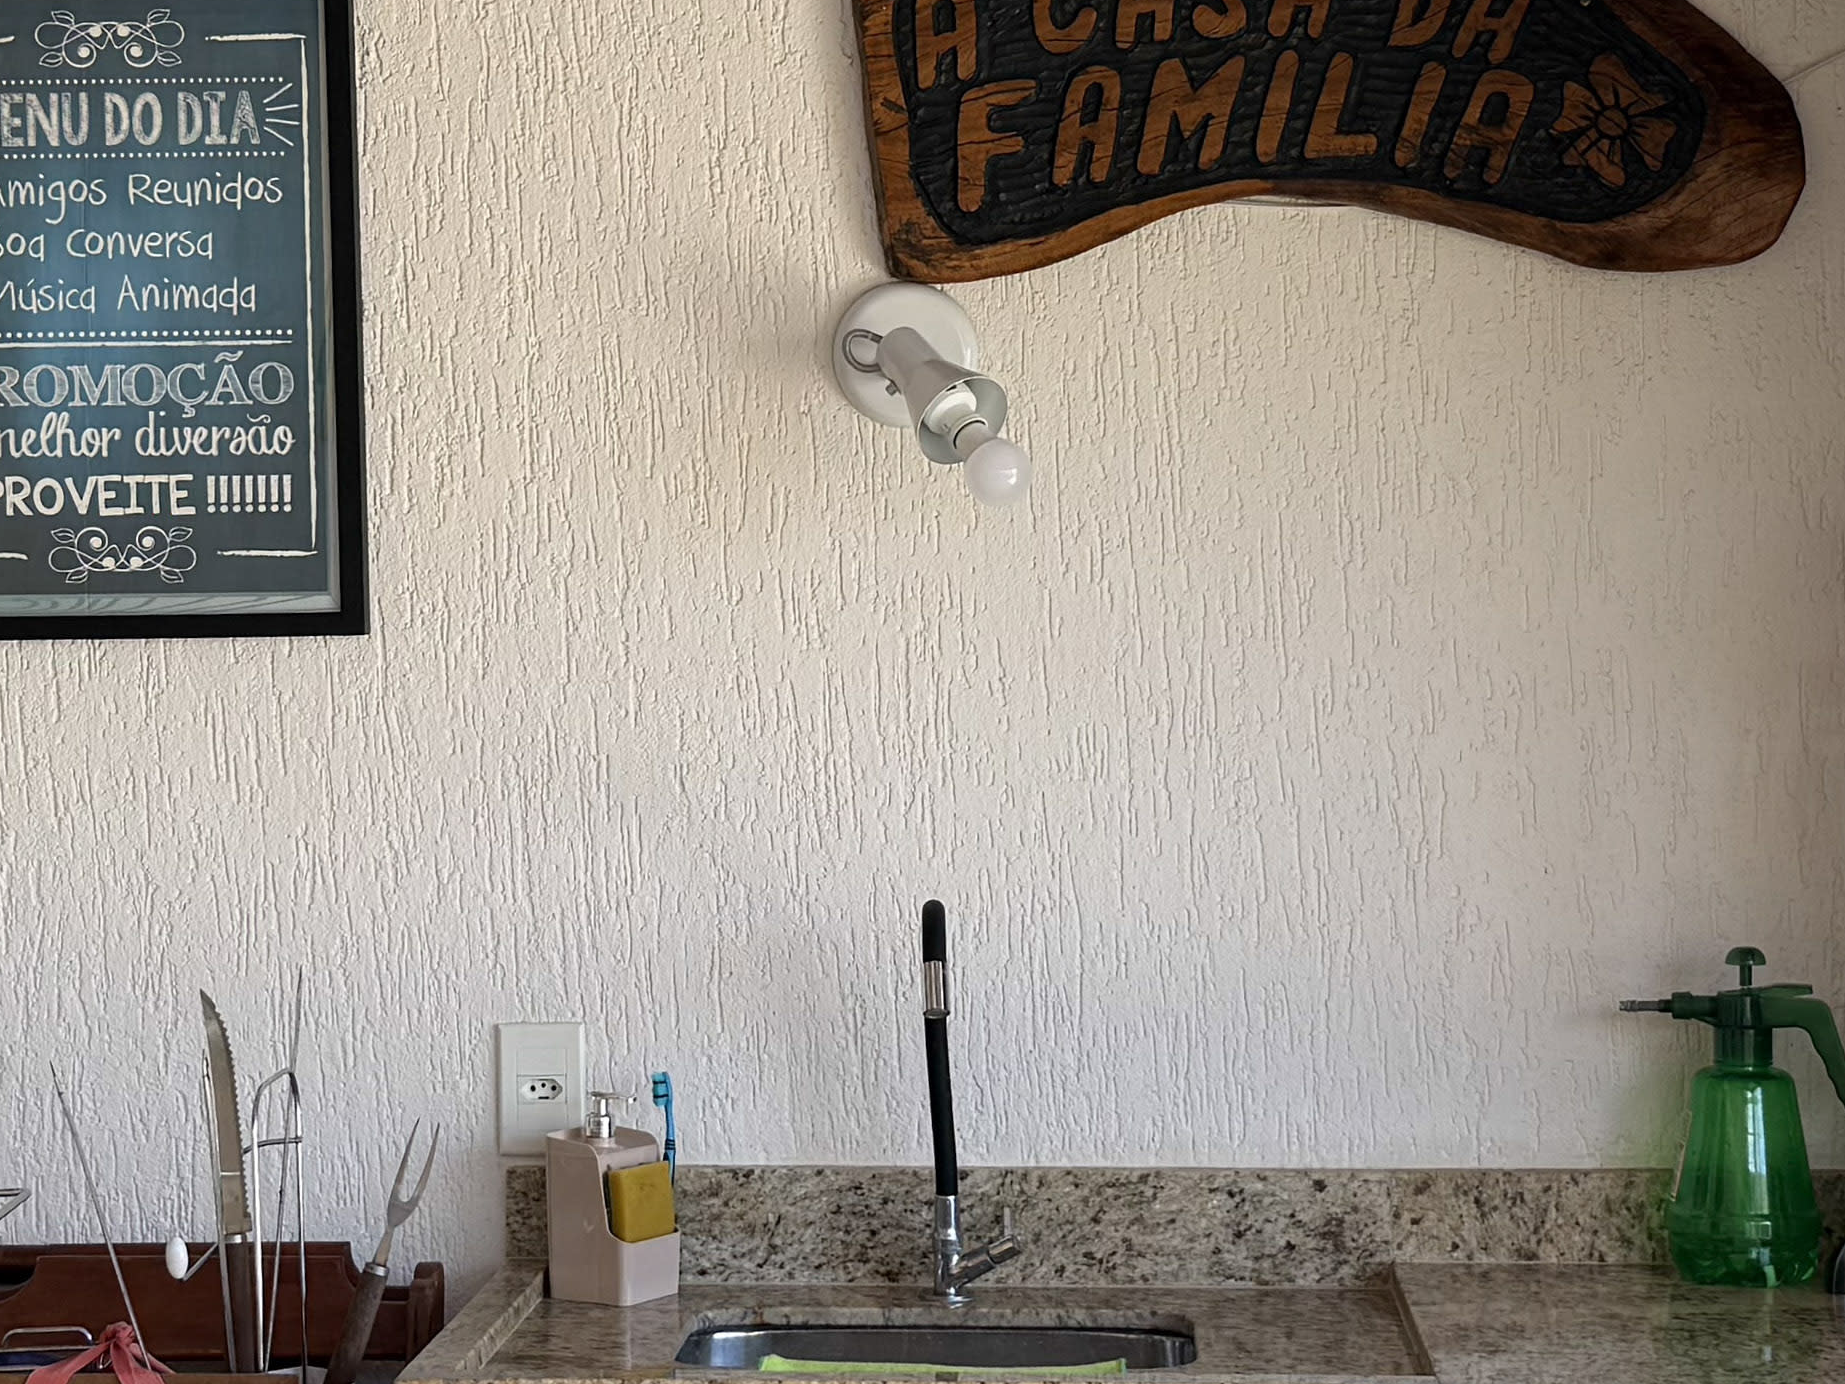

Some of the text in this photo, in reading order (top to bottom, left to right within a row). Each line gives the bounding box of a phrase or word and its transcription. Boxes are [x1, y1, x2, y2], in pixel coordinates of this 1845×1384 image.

[103, 91, 163, 147] DO
[177, 89, 261, 146] DIA
[956, 49, 1536, 213] FAMILIA
[127, 170, 284, 211] Reunidos
[116, 273, 256, 314] Animada
[134, 412, 297, 458] diversão
